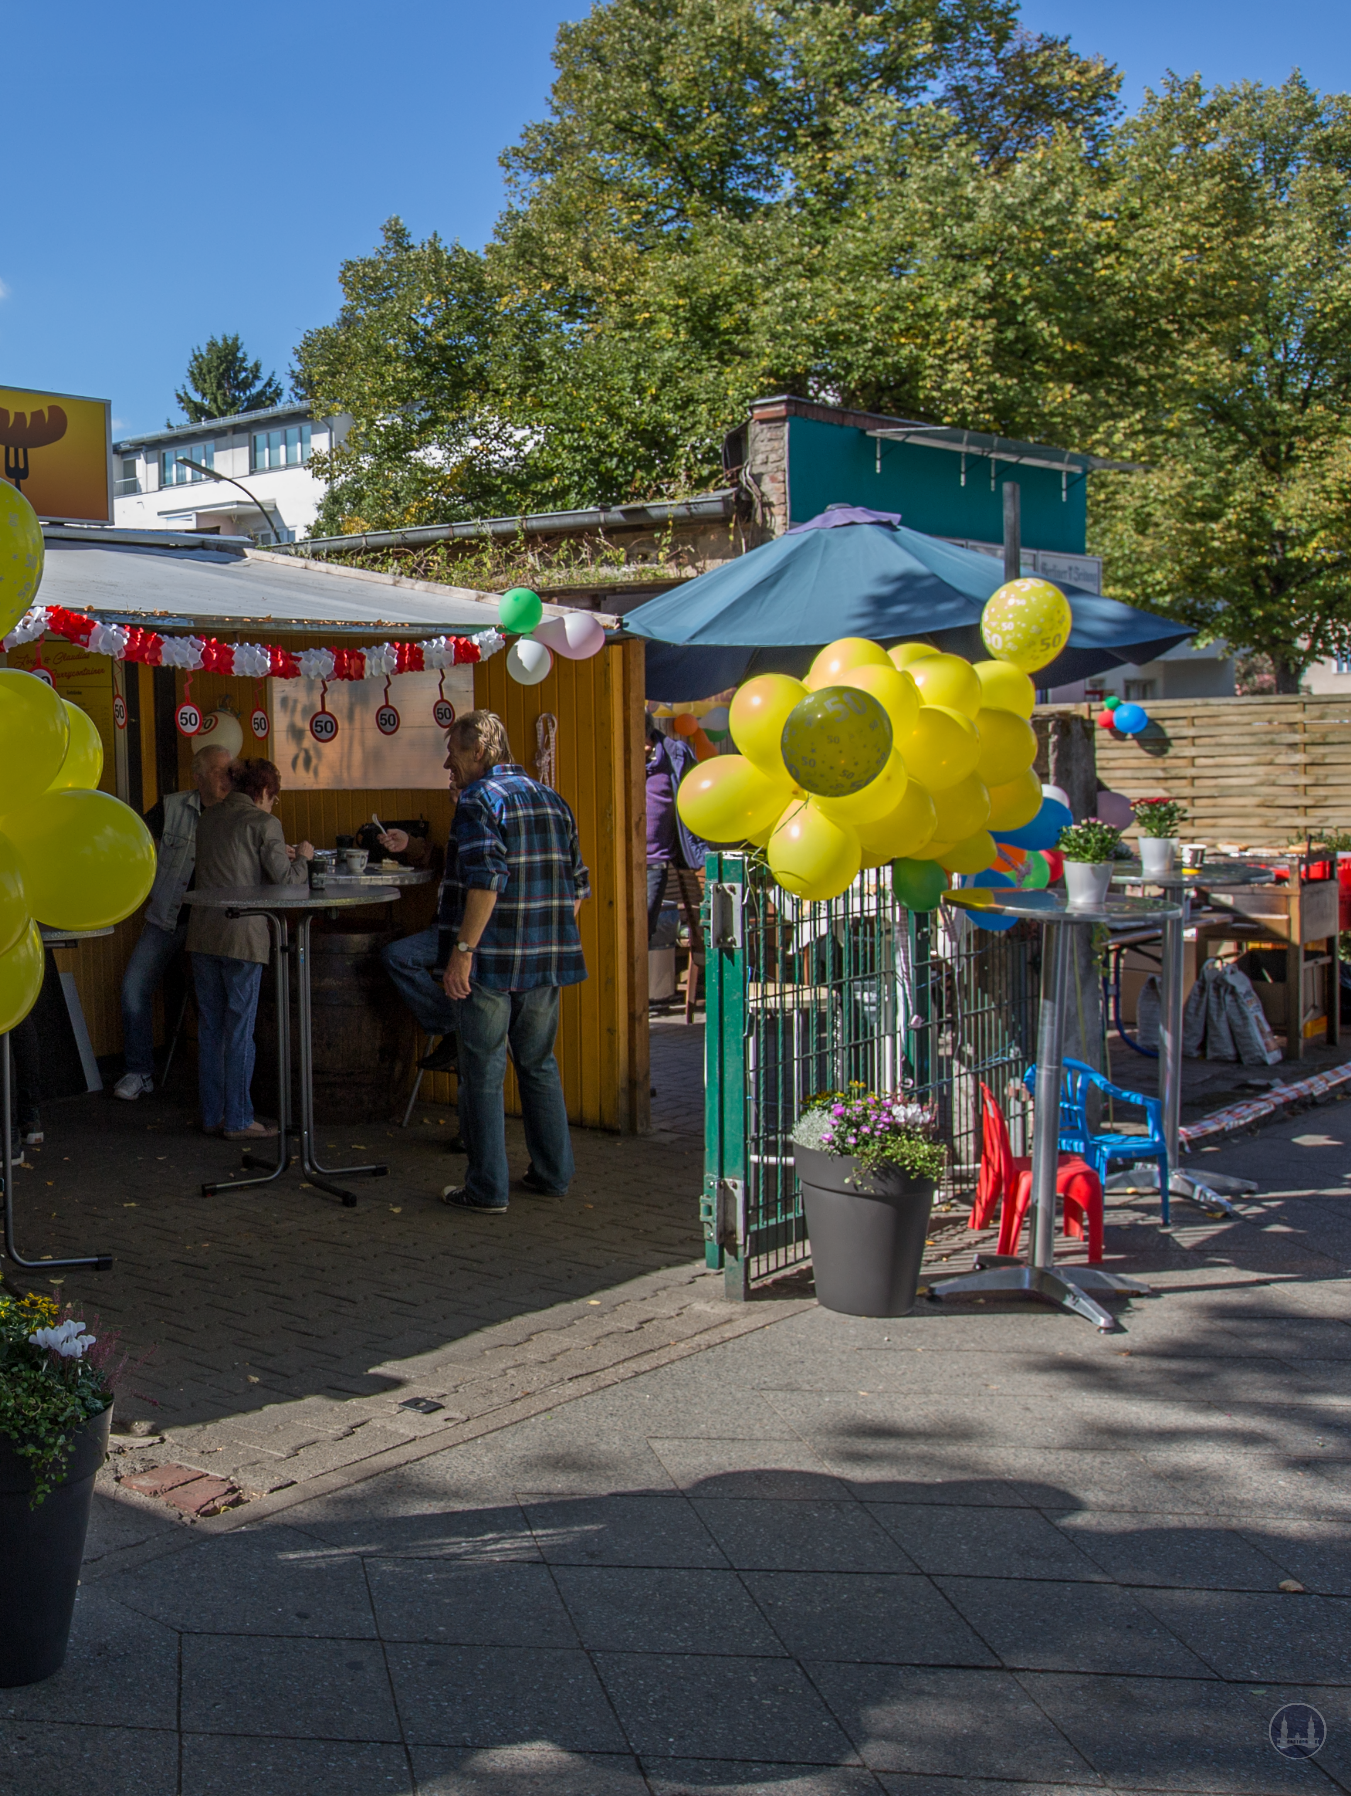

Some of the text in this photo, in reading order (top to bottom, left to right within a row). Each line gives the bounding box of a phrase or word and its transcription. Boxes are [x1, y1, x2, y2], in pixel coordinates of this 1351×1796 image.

[1014, 578, 1044, 592] 50
[984, 628, 1002, 650] 50
[1040, 633, 1061, 652] 50
[115, 704, 124, 719] 50
[436, 708, 452, 720] 50
[824, 691, 868, 723] 50
[180, 712, 198, 726] 50
[253, 717, 266, 731] 50
[380, 714, 396, 727] 50
[314, 720, 334, 734] 50
[802, 756, 816, 767] 50
[841, 770, 854, 779] 50
